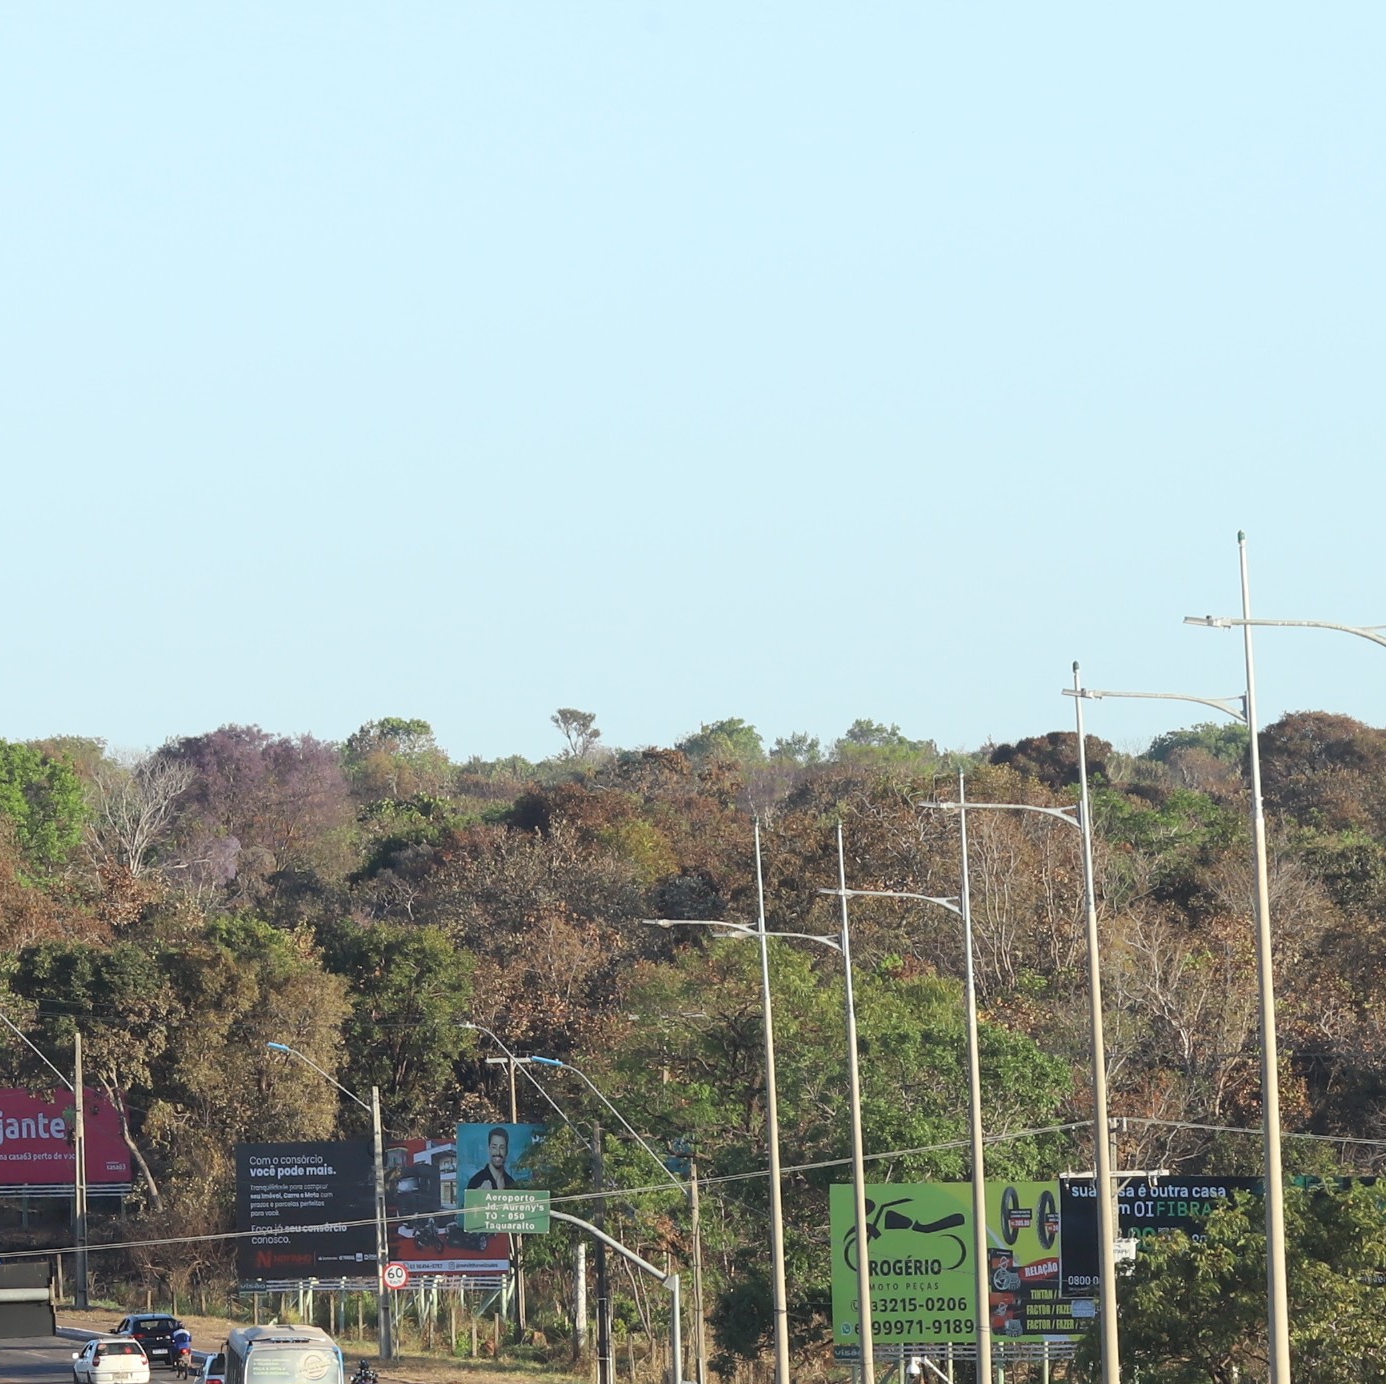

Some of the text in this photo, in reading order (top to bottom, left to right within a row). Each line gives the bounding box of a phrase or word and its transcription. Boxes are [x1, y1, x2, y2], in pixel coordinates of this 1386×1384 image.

[8, 1152, 32, 1161] casa63
[33, 1153, 52, 1162] perto
[53, 1152, 63, 1160] de
[249, 1156, 271, 1166] Com
[280, 1154, 324, 1165] consórcio
[250, 1163, 337, 1180] você pode mais.
[1071, 1185, 1097, 1198] sua
[1138, 1183, 1147, 1198] é
[1150, 1184, 1189, 1198] outra
[1192, 1186, 1227, 1198] casa
[485, 1193, 535, 1203] Aeroporto
[502, 1202, 545, 1213] Aureny's
[485, 1212, 498, 1220] TO
[508, 1212, 525, 1220] 050
[484, 1221, 535, 1231] Taquaralto
[251, 1235, 291, 1245] conosco.
[869, 1254, 942, 1277] ROGÉRIO
[1024, 1261, 1059, 1278] RELAÇÃO
[387, 1267, 403, 1279] 60
[1068, 1275, 1091, 1286] 0800
[869, 1282, 939, 1292] MOTO PEÇAS
[879, 1297, 967, 1313] 3215-0206
[1026, 1304, 1051, 1315] FACTOR
[1056, 1304, 1072, 1315] FAZE
[872, 1318, 974, 1336] 99971-9189
[1026, 1319, 1051, 1330] FACTOR
[1056, 1319, 1074, 1330] FAZER
